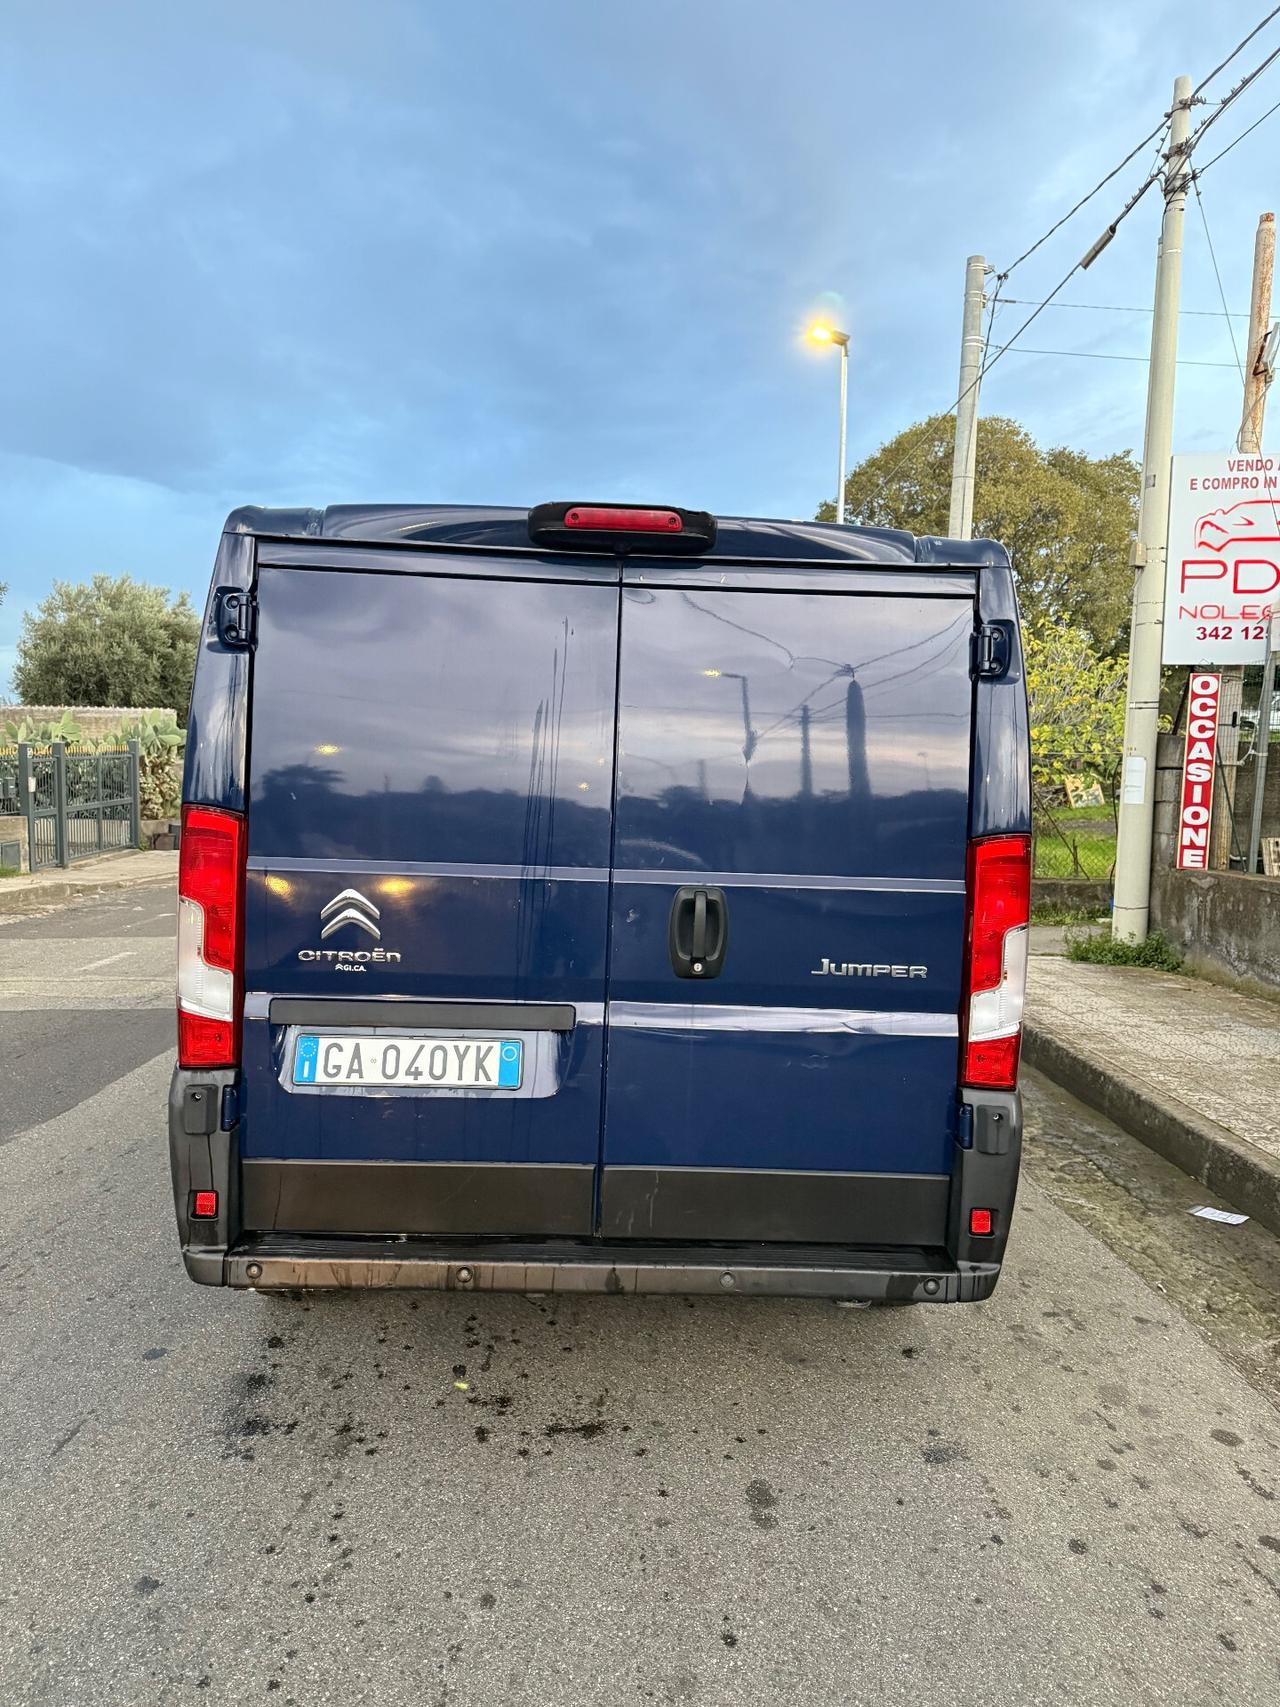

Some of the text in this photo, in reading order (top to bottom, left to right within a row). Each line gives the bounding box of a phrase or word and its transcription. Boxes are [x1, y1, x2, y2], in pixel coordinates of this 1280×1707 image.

[1227, 459, 1273, 472] VENDO
[1189, 476, 1277, 490] E COMPRO IN
[1180, 559, 1280, 594] PD
[1196, 626, 1269, 640] 342 12
[1182, 675, 1219, 868] OCCASIONE
[323, 1042, 364, 1079] GA
[381, 1044, 494, 1082] 040YK
